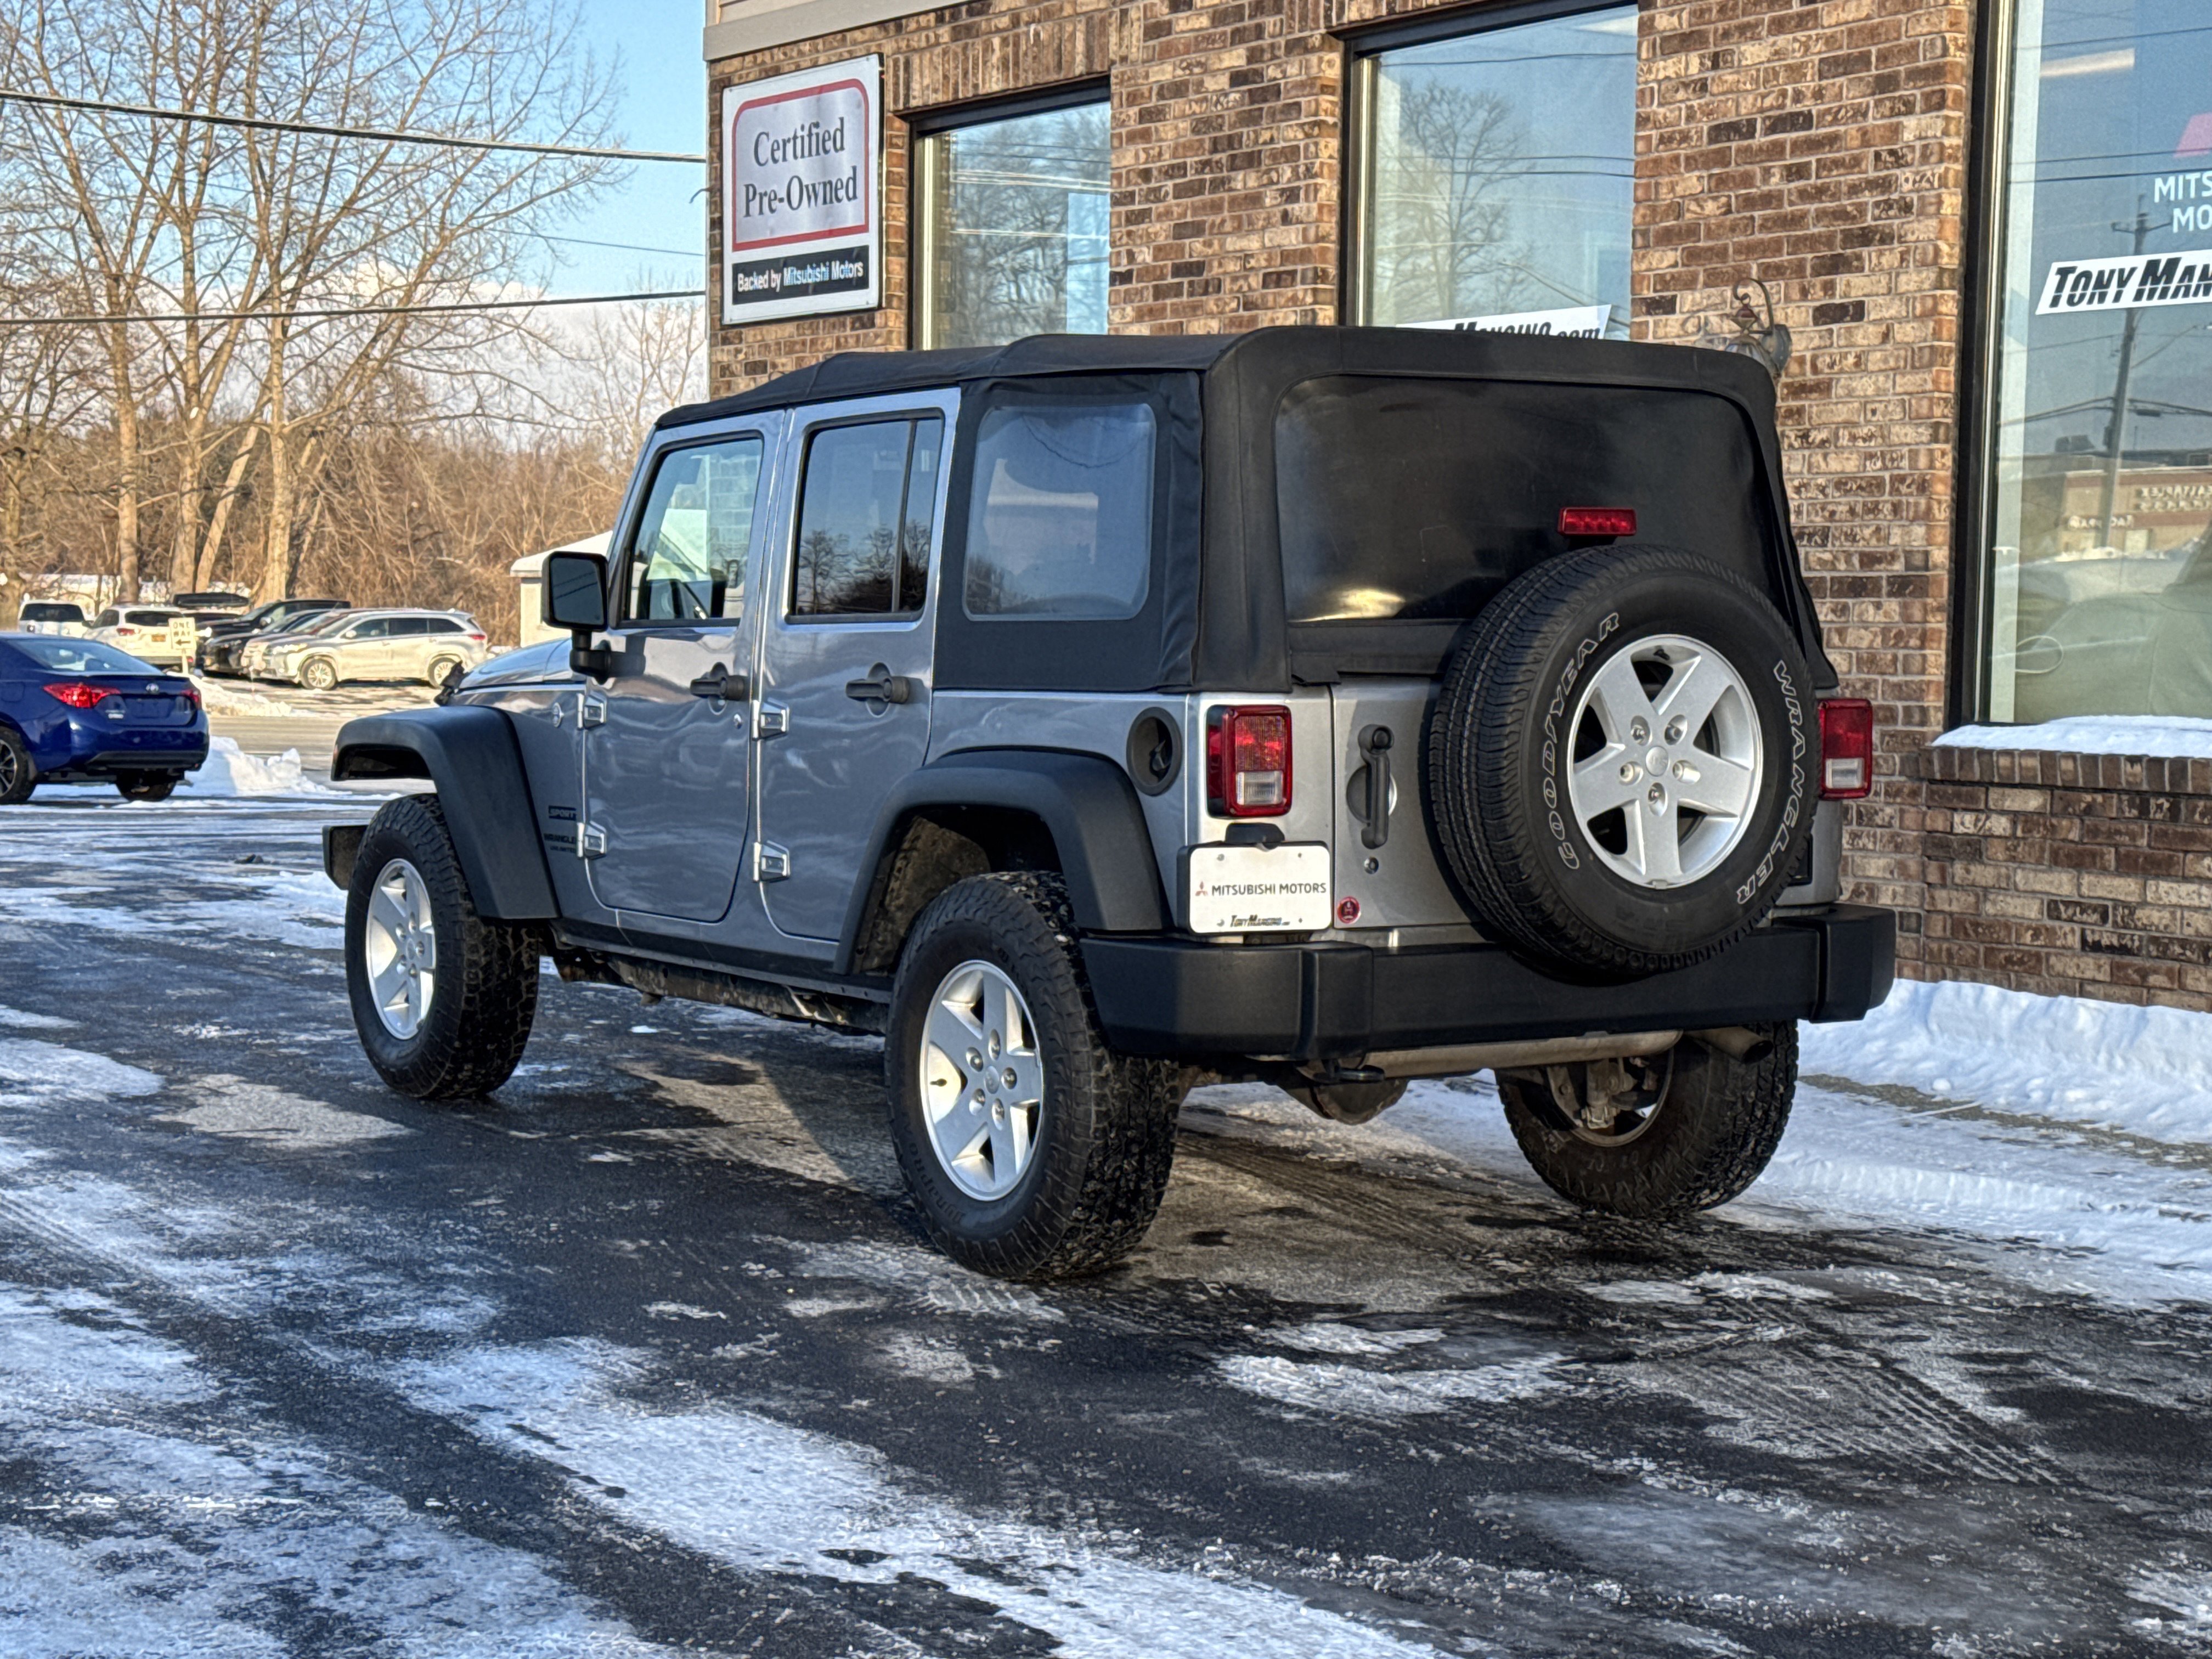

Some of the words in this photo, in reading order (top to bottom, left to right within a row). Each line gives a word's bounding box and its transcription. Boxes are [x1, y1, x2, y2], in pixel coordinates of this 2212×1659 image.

[753, 117, 845, 167] Certified
[743, 165, 858, 217] Pre-Owned
[2153, 171, 2212, 204] MITS
[737, 272, 769, 292] Backed
[770, 269, 782, 292] by
[783, 261, 829, 287] Mitsubishi
[831, 260, 864, 280] Motors
[173, 621, 190, 629] ONE
[1542, 612, 1621, 870] GOODYEAR
[1737, 660, 1807, 904] WRANGLER
[549, 809, 575, 819] SPORT
[1211, 883, 1276, 896] MITSUBISHI
[1279, 882, 1327, 894] MOTORS
